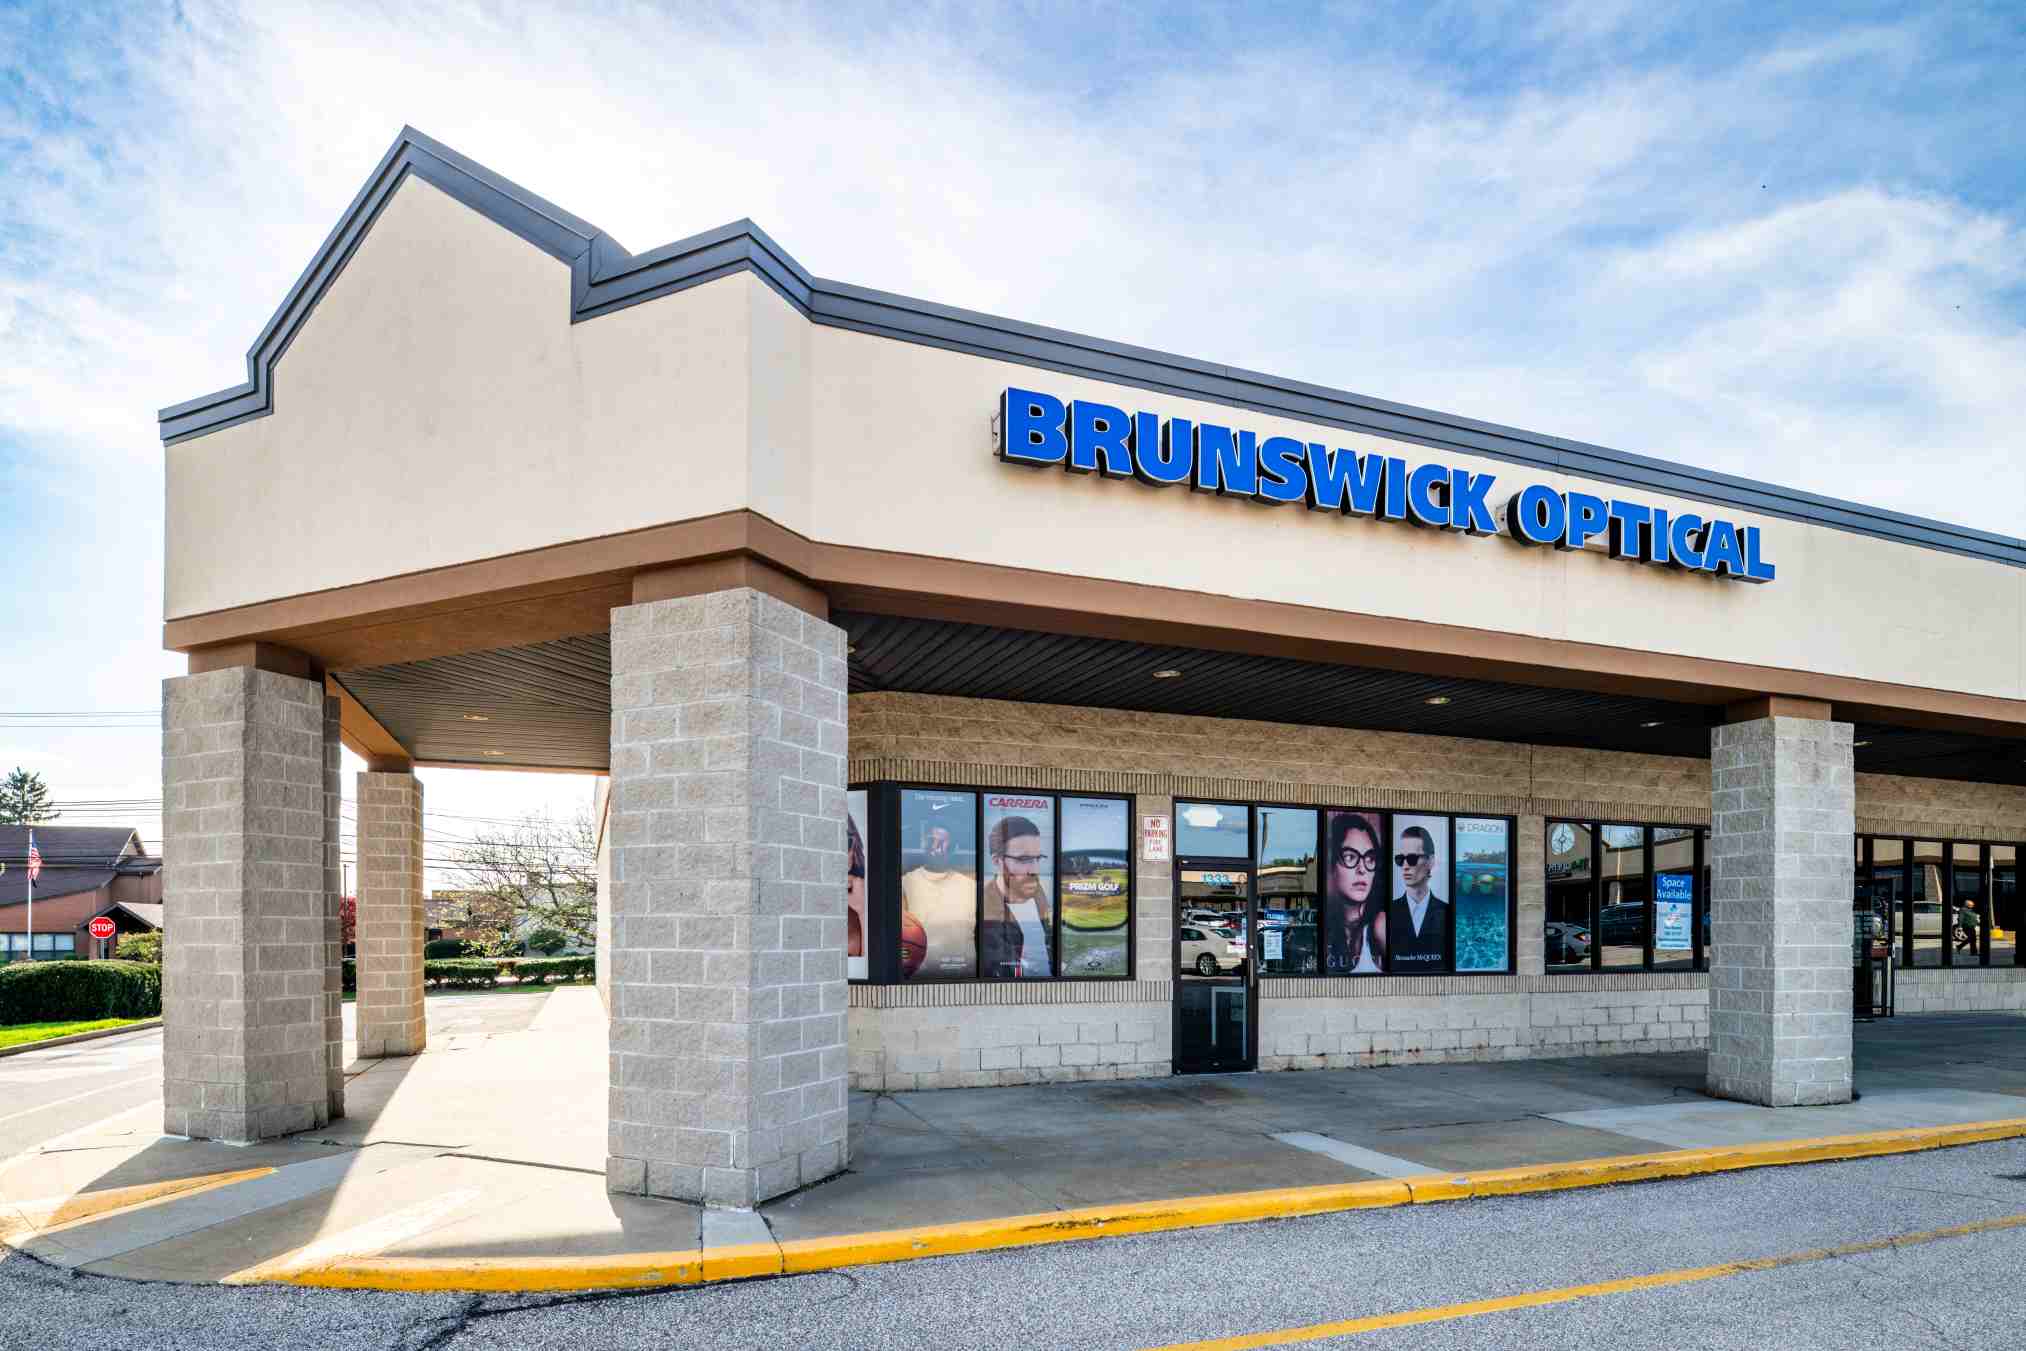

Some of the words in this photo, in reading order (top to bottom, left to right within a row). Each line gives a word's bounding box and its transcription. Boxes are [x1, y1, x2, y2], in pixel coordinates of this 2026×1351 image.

[1002, 387, 1497, 535] BRUNSWICK
[1511, 485, 1775, 584] OPTICAL
[989, 797, 1049, 809] CARRERA
[1151, 818, 1161, 829] NO
[1467, 823, 1503, 833] DRAGON
[1098, 883, 1120, 891] GOLF
[1662, 877, 1685, 889] Space
[1657, 889, 1691, 899] Available
[91, 923, 113, 932] STOP
